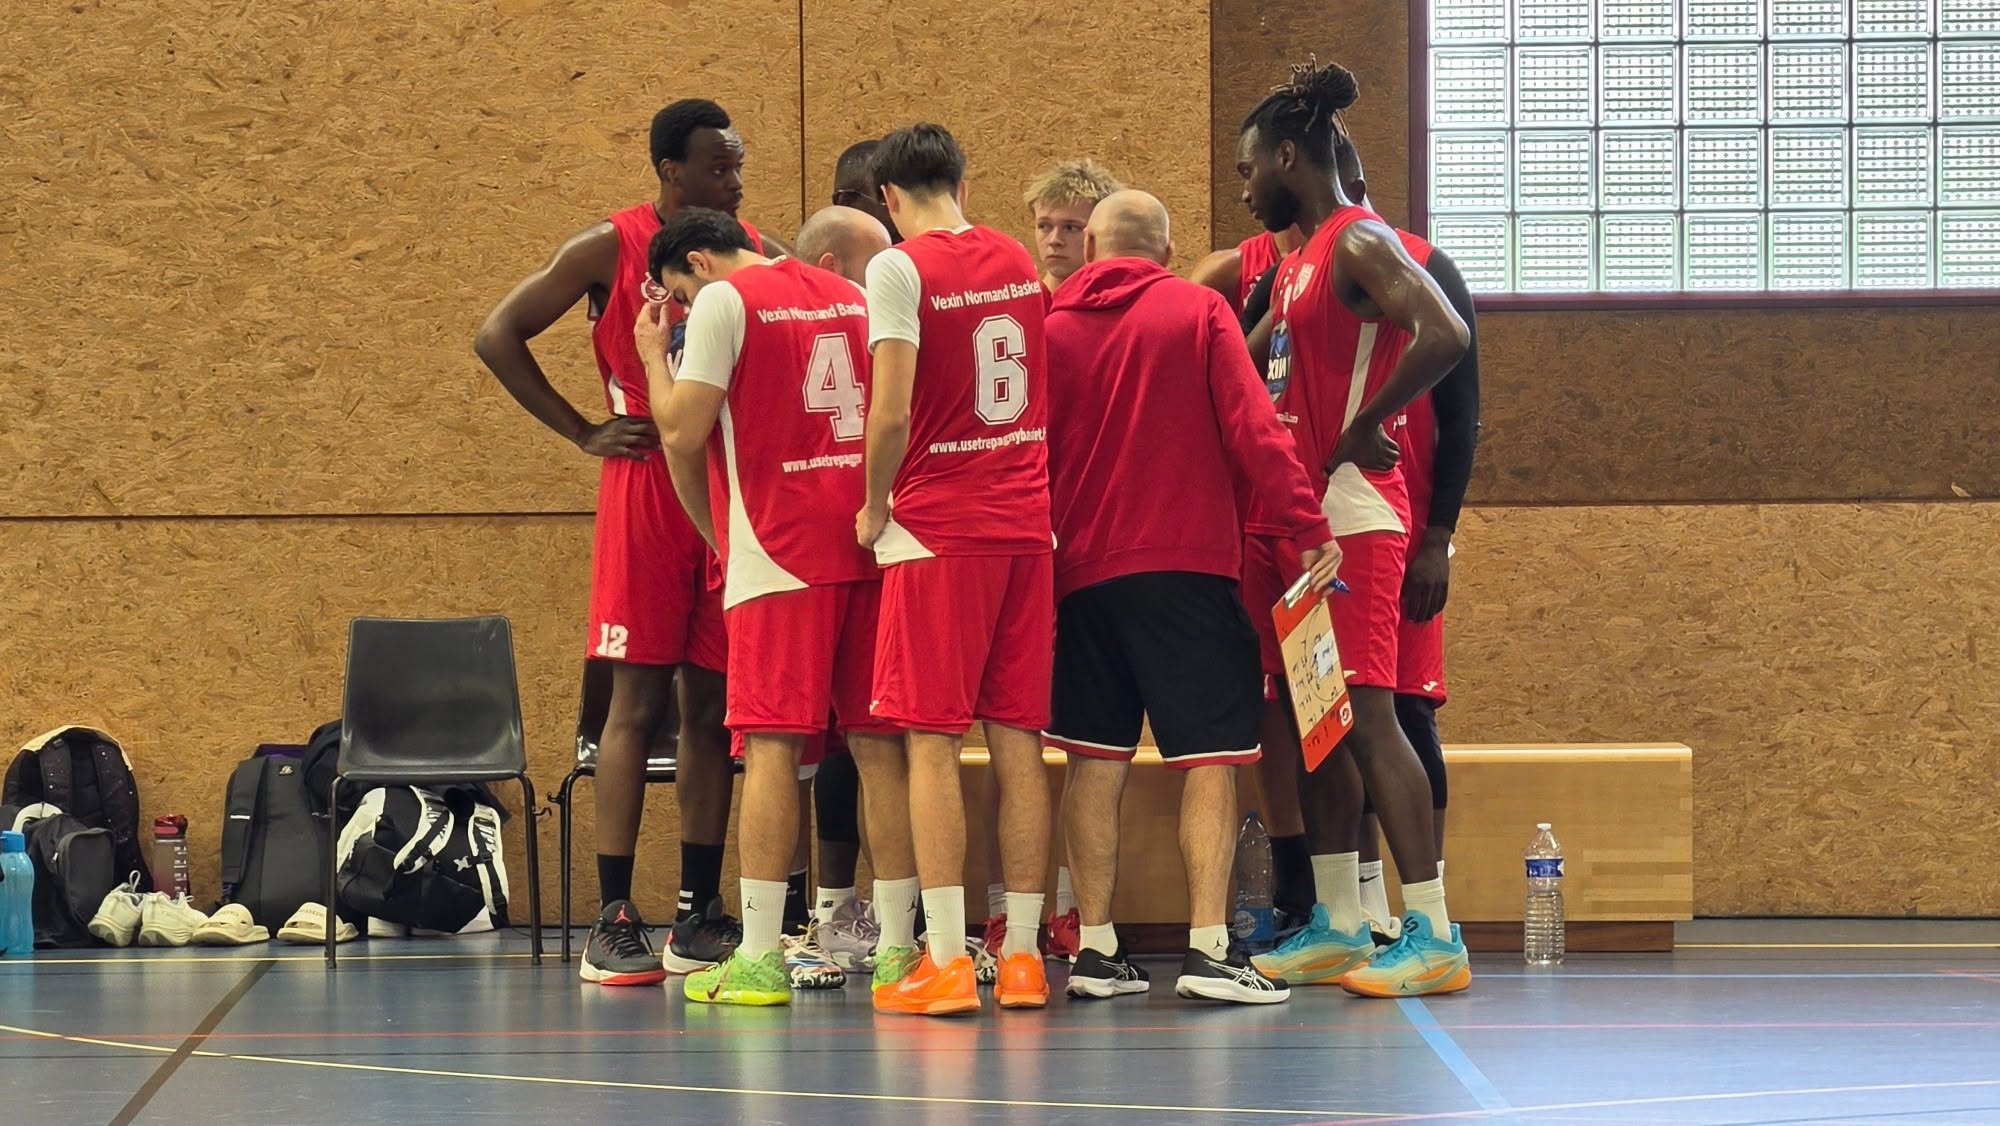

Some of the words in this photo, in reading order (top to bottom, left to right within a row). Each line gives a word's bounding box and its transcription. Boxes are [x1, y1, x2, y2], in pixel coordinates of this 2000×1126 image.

[757, 306, 791, 324] Vexin
[788, 304, 838, 321] Normand
[930, 292, 964, 311] Vexin
[964, 284, 1011, 306] Normand
[802, 332, 865, 442] 4
[972, 314, 1029, 425] 6
[596, 622, 628, 659] 12
